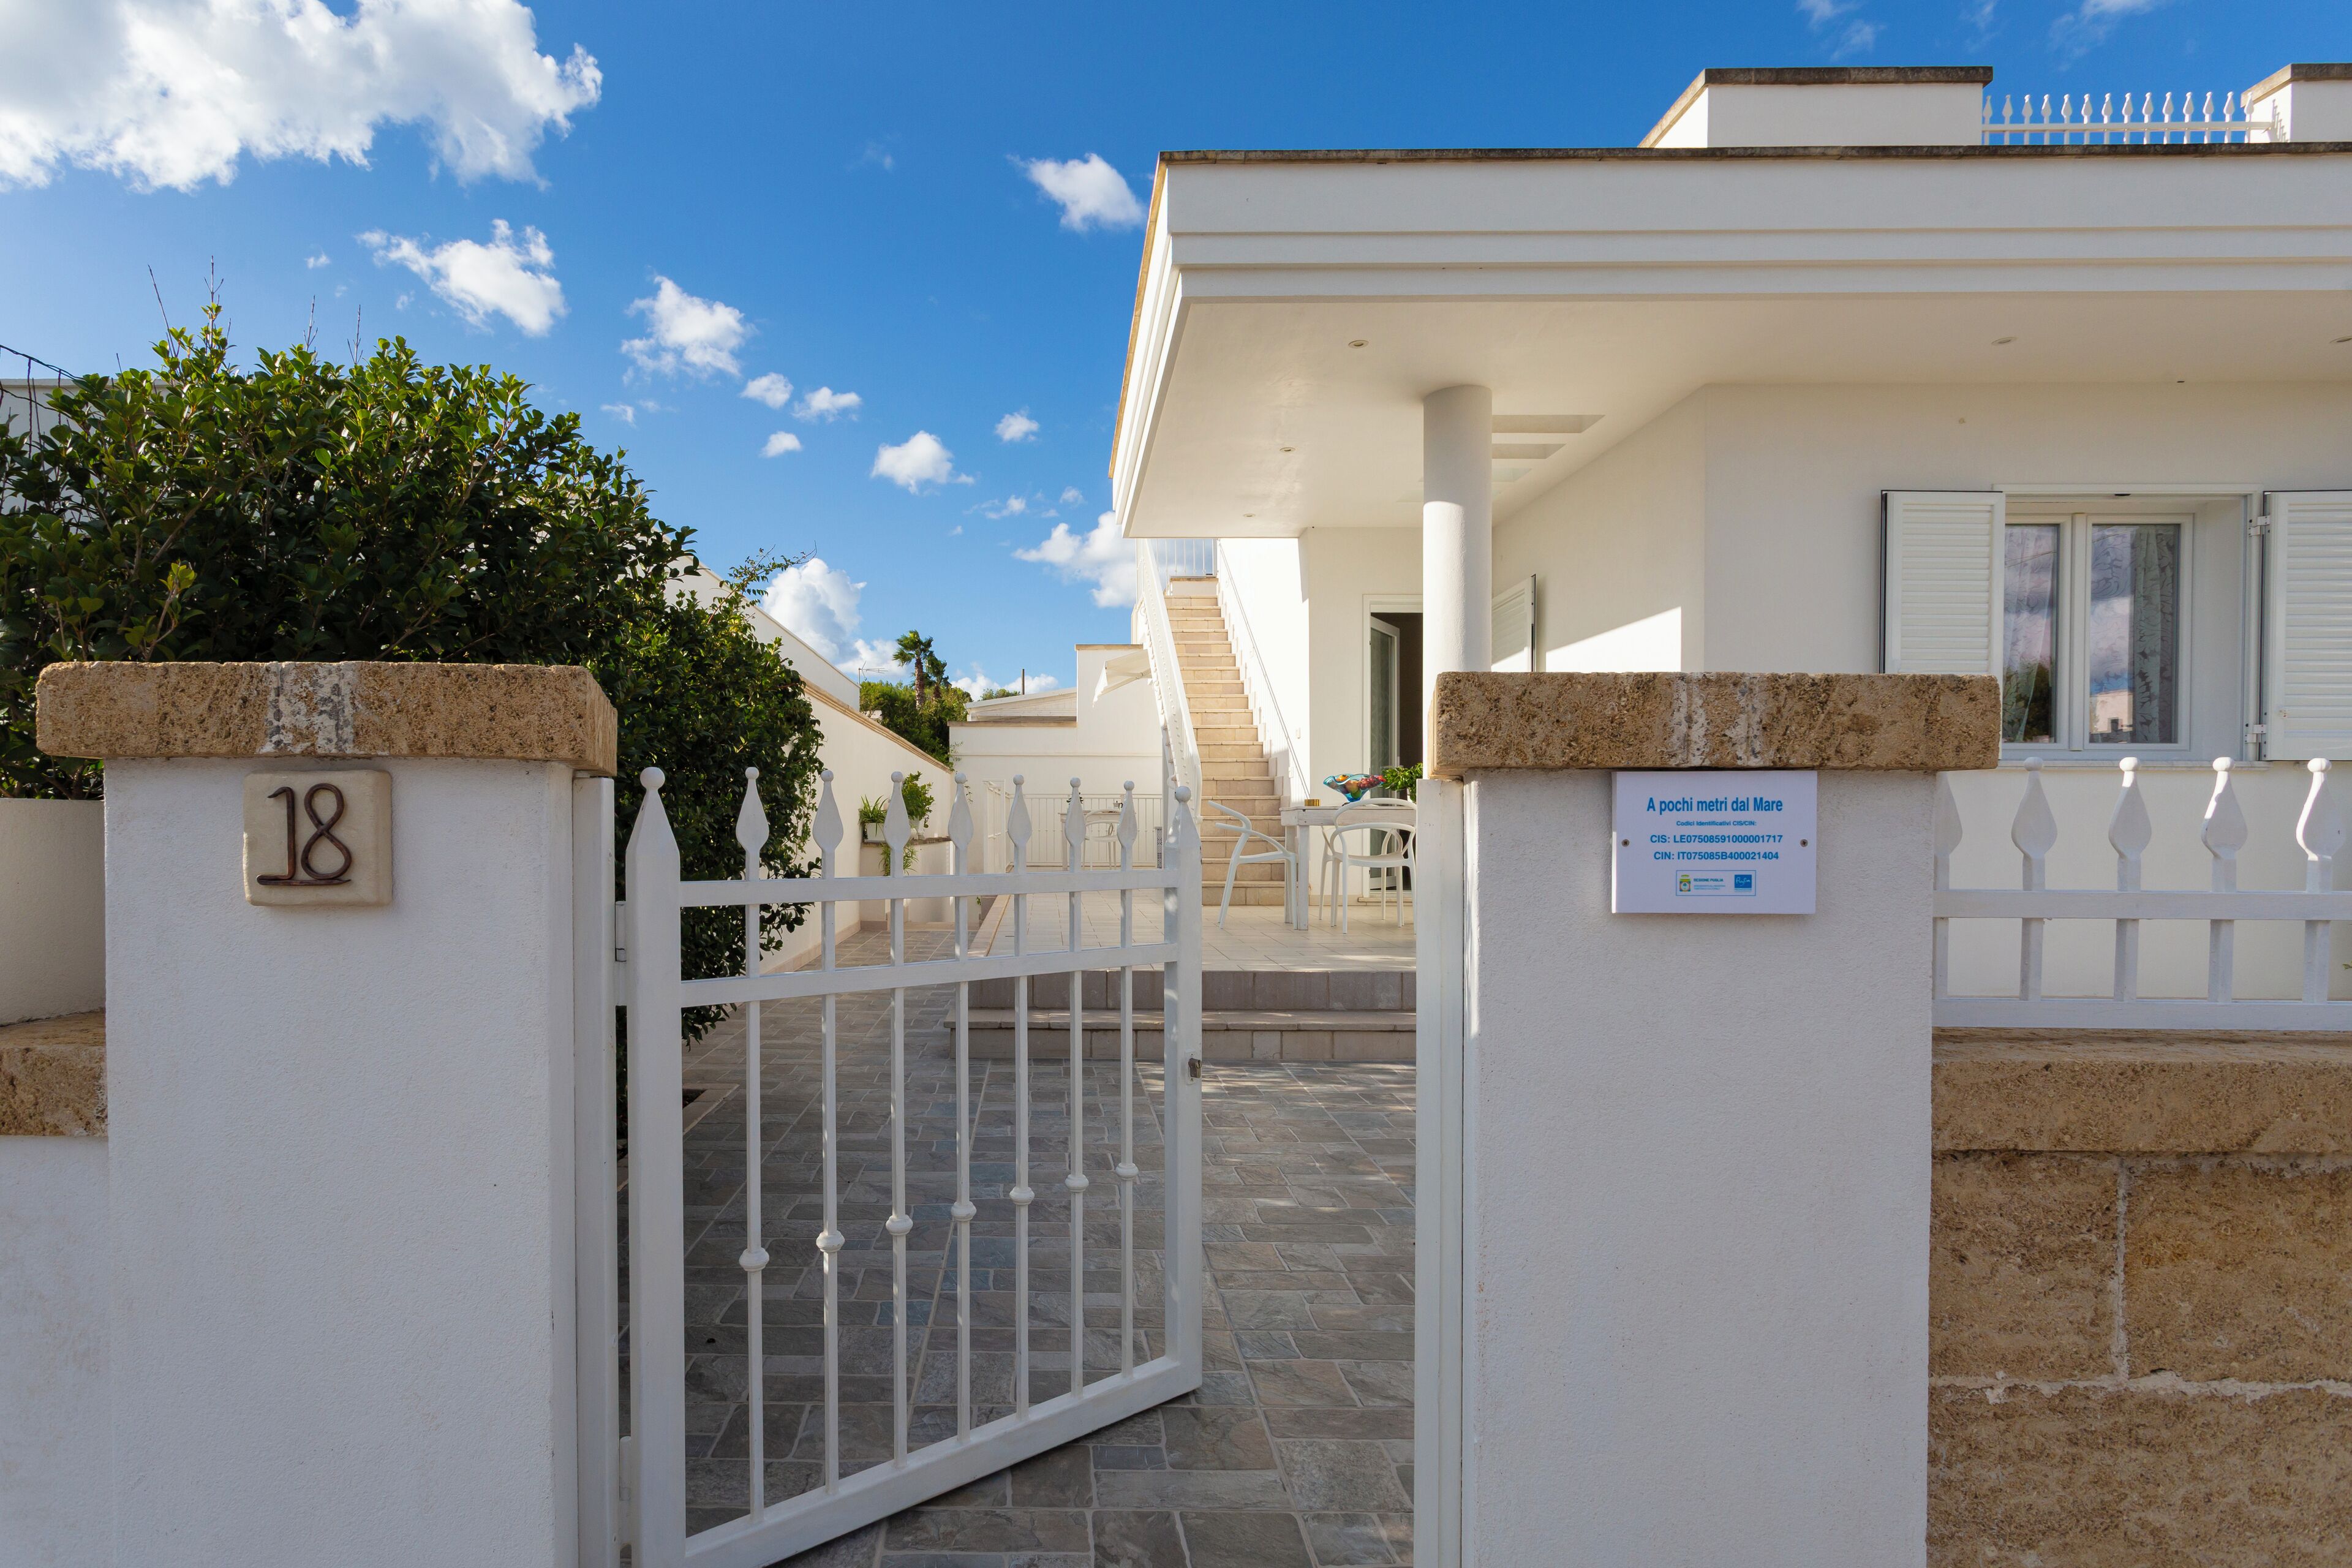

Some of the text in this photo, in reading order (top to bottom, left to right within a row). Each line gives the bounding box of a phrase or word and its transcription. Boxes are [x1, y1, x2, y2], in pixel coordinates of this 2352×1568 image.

[1646, 797, 1784, 816] A pochi metri dal Mare
[256, 783, 352, 886] 18
[1650, 834, 1783, 843] CIS: LE07508591000001717
[1654, 851, 1779, 861] CIN: IT075085B400021404
